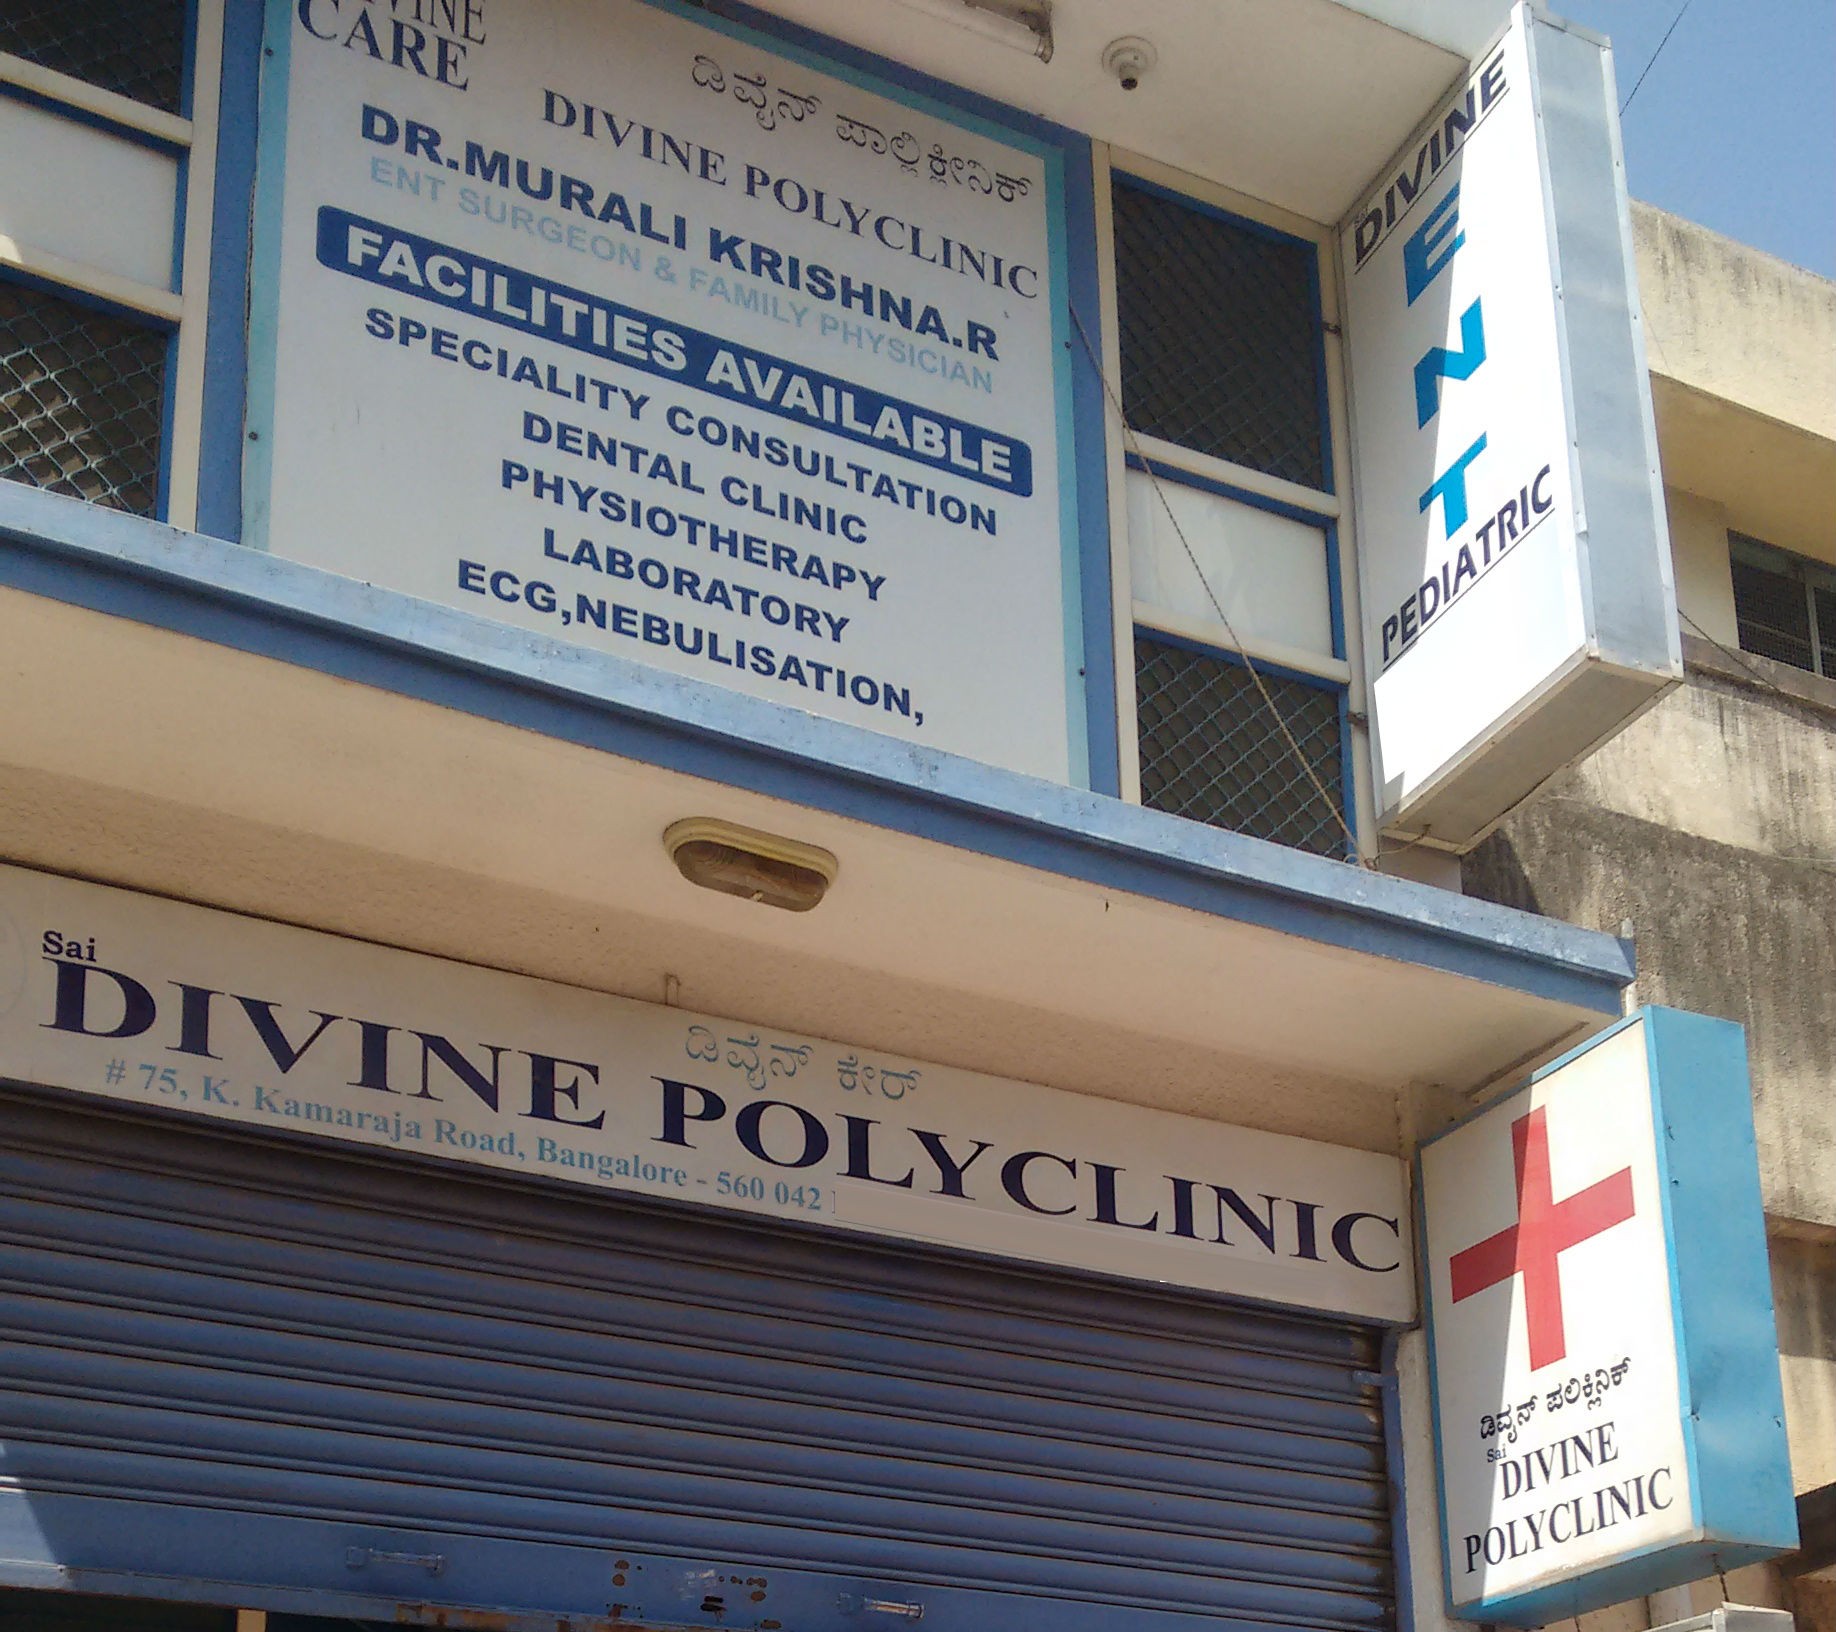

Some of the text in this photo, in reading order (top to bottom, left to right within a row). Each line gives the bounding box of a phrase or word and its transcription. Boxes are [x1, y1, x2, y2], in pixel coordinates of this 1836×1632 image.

[298, 0, 468, 91] CARE
[361, 103, 1000, 362] DR.MURALI KRISHNA.R
[541, 88, 1038, 300] DIVINE POLYCLINIC
[1354, 48, 1507, 266] DIVINE
[346, 224, 1013, 483] FACILITIES AVAILABLE
[369, 155, 993, 395] ENT SURGEON & FAMILY PHYSICIAN
[1403, 181, 1487, 541] ENT
[364, 307, 997, 537] SPECIALITY CONSULTATION
[523, 410, 868, 544] DENTAL CLINIC
[502, 458, 887, 602] PHYSIOTHERAPY
[544, 527, 851, 644] LABORATORY
[1382, 464, 1553, 664] PEDIATRIC
[42, 930, 97, 962] Sai
[38, 956, 1400, 1273] DIVINE POLYCLINIC
[138, 1062, 189, 1102] 75,
[201, 1075, 240, 1108] K.
[254, 1085, 423, 1143] Kamaraja
[434, 1118, 526, 1161] Road,
[536, 1136, 688, 1188] Bangalore
[716, 1170, 765, 1202] 560
[773, 1179, 823, 1212] 042
[1463, 1465, 1674, 1574] POLYCLINIC
[1486, 1443, 1507, 1463] Sai
[1498, 1421, 1620, 1501] DIVINE
